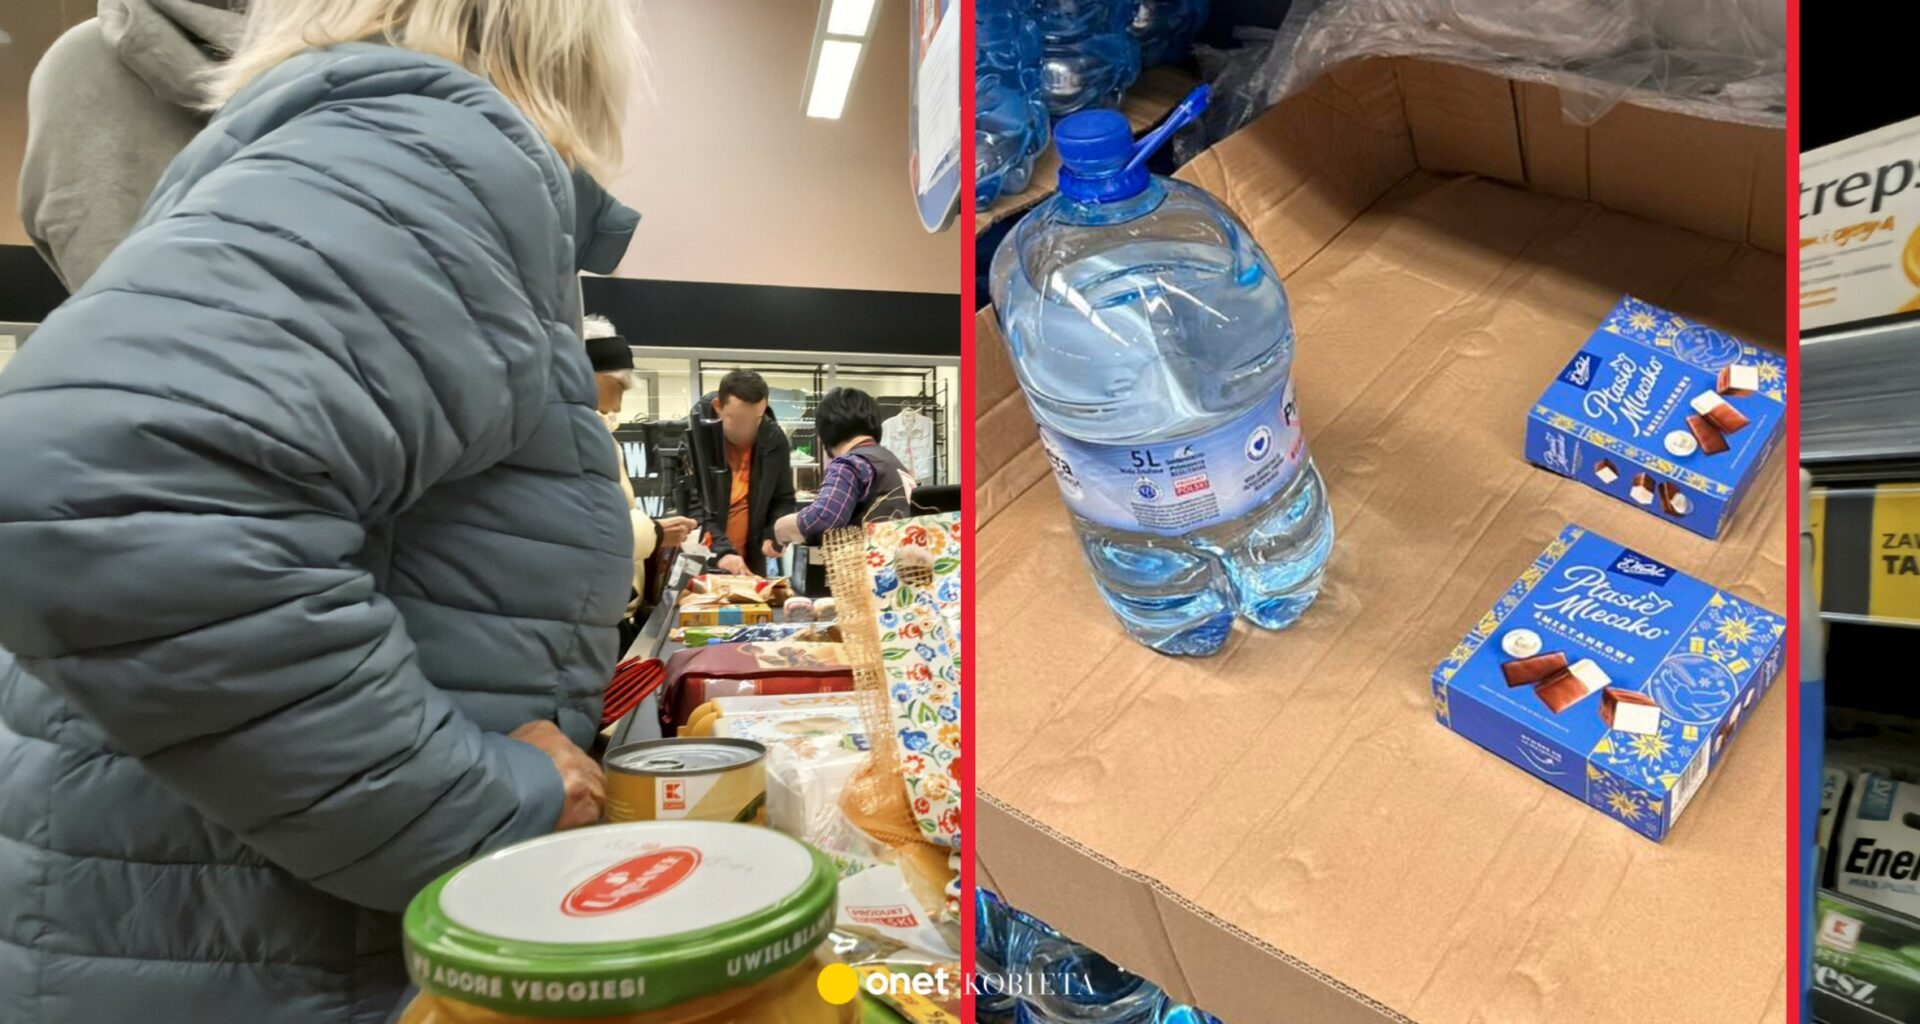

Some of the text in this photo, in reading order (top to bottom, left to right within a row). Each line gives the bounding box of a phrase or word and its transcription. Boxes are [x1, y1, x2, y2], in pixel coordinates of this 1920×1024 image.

[1583, 352, 1637, 425] Ptasie
[1552, 564, 1673, 616] Ptasie
[433, 966, 502, 998] ADORE
[511, 975, 646, 1002] VEGGIES!
